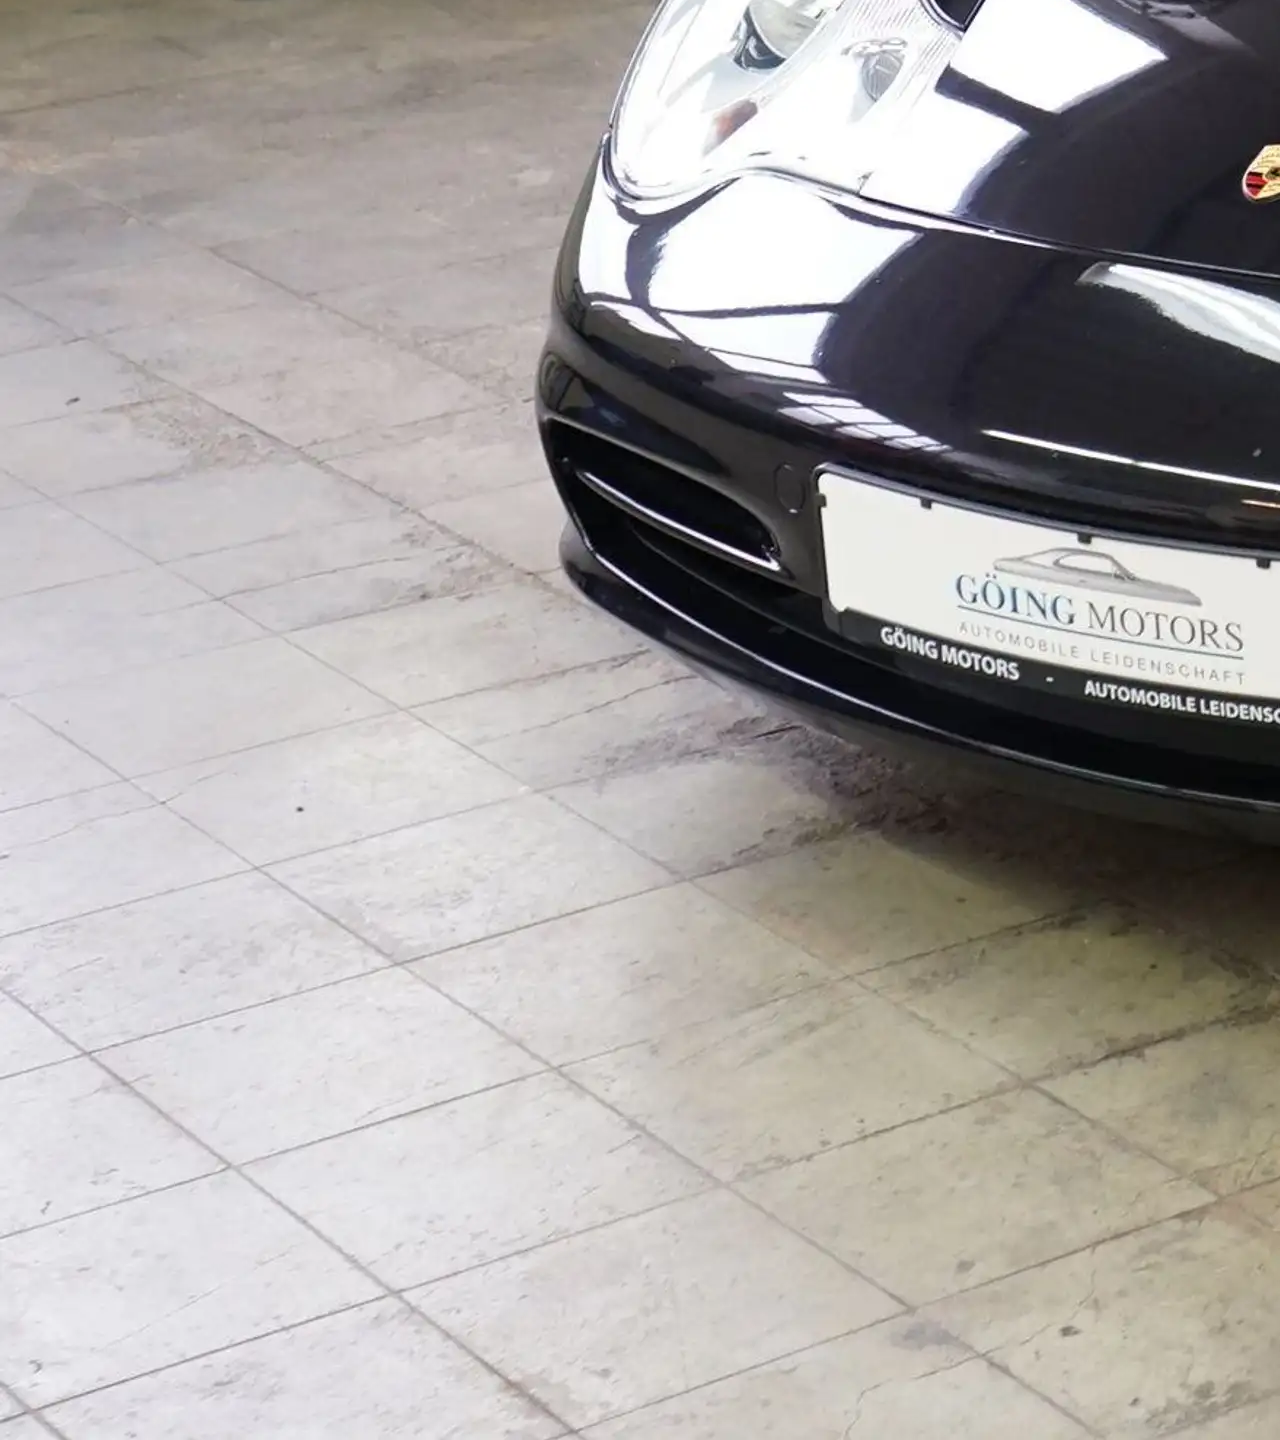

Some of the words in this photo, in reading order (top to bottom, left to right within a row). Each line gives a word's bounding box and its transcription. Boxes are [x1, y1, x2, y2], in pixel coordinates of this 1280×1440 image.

[955, 572, 1075, 626] GÖING
[1086, 600, 1244, 653] MOTORS
[880, 626, 938, 660] GÖING
[940, 644, 1020, 681] MOTORS
[1084, 679, 1197, 712] AUTOMOBILE
[959, 622, 1079, 659] AUTOMOBILE
[1091, 651, 1247, 685] LEIDENSCHAFT
